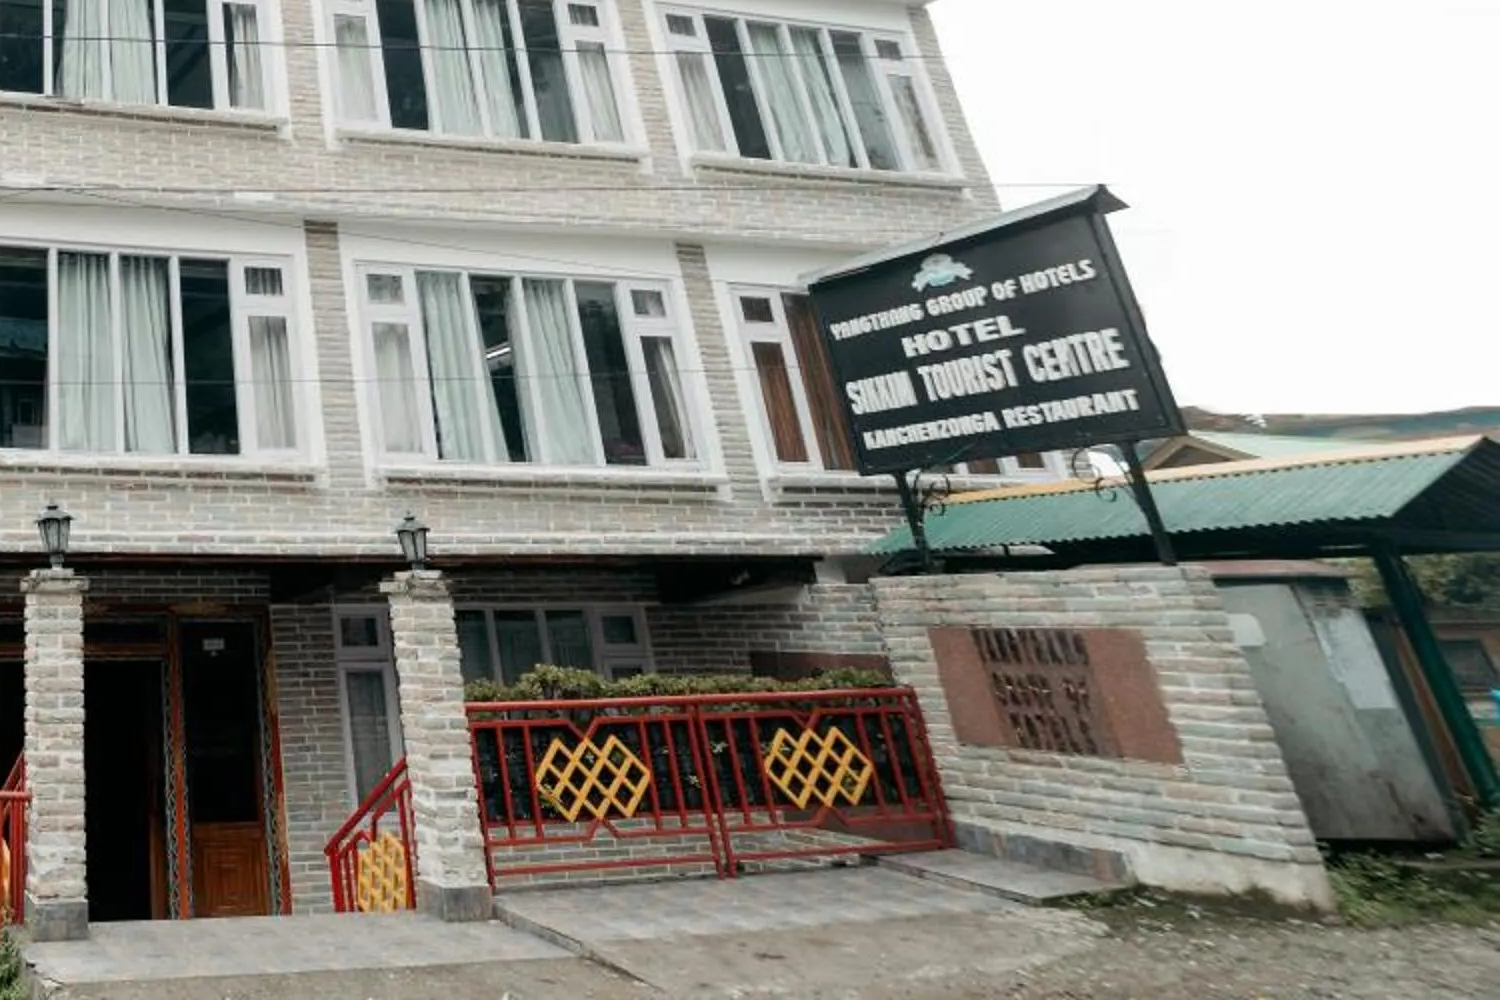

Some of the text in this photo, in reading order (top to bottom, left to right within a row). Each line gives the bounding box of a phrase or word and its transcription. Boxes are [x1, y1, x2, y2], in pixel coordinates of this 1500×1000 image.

[925, 285, 988, 317] GROUP
[991, 279, 1018, 301] OF
[1018, 258, 1097, 294] HOTELS
[900, 315, 1027, 358] HOTEL
[845, 327, 1131, 415] SIKKIM TOURIST CENTRE
[1001, 388, 1140, 429] RESTAURANT
